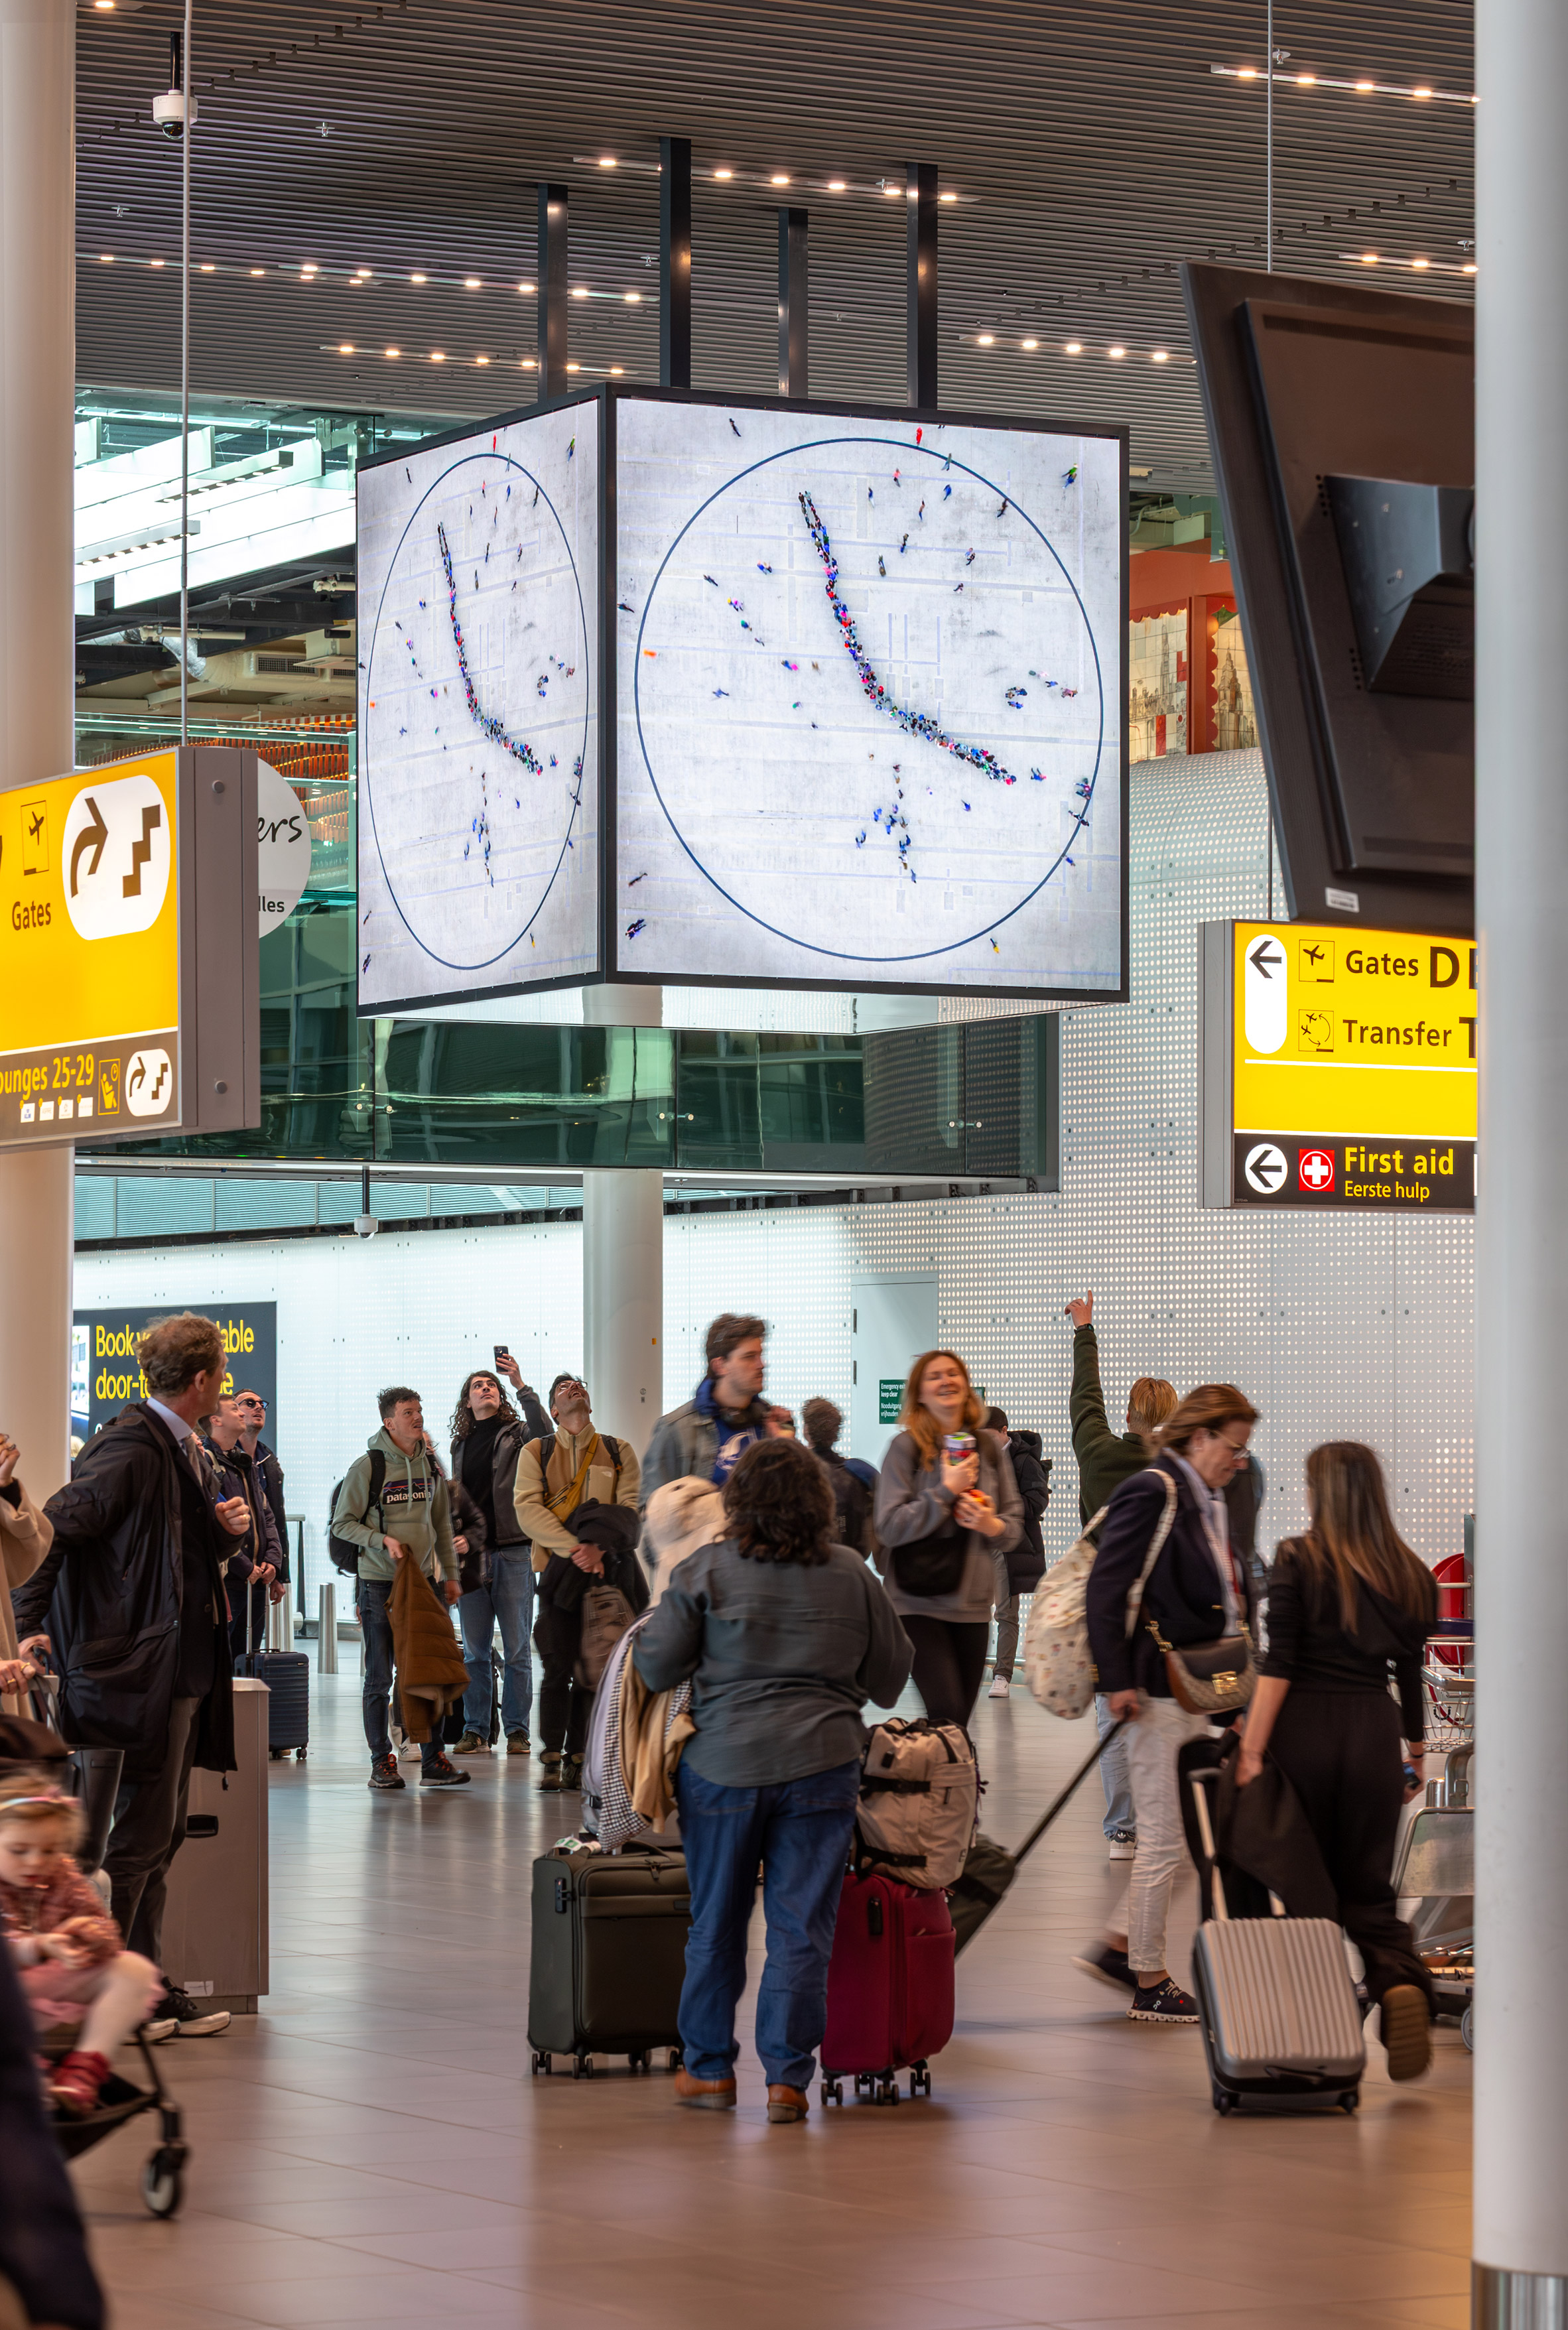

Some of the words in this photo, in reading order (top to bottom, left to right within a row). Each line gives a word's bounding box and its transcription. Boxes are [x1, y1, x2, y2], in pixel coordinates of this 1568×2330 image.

[12, 900, 51, 931] Gates
[1346, 950, 1419, 976] Gates
[1430, 946, 1460, 988] D
[1342, 1019, 1452, 1047] Transfer
[52, 1053, 94, 1088] 25-29
[1345, 1146, 1404, 1174] First
[1413, 1149, 1454, 1175] aid
[1344, 1181, 1392, 1198] Eerste
[1396, 1181, 1430, 1202] hulp
[96, 1325, 135, 1357] Book
